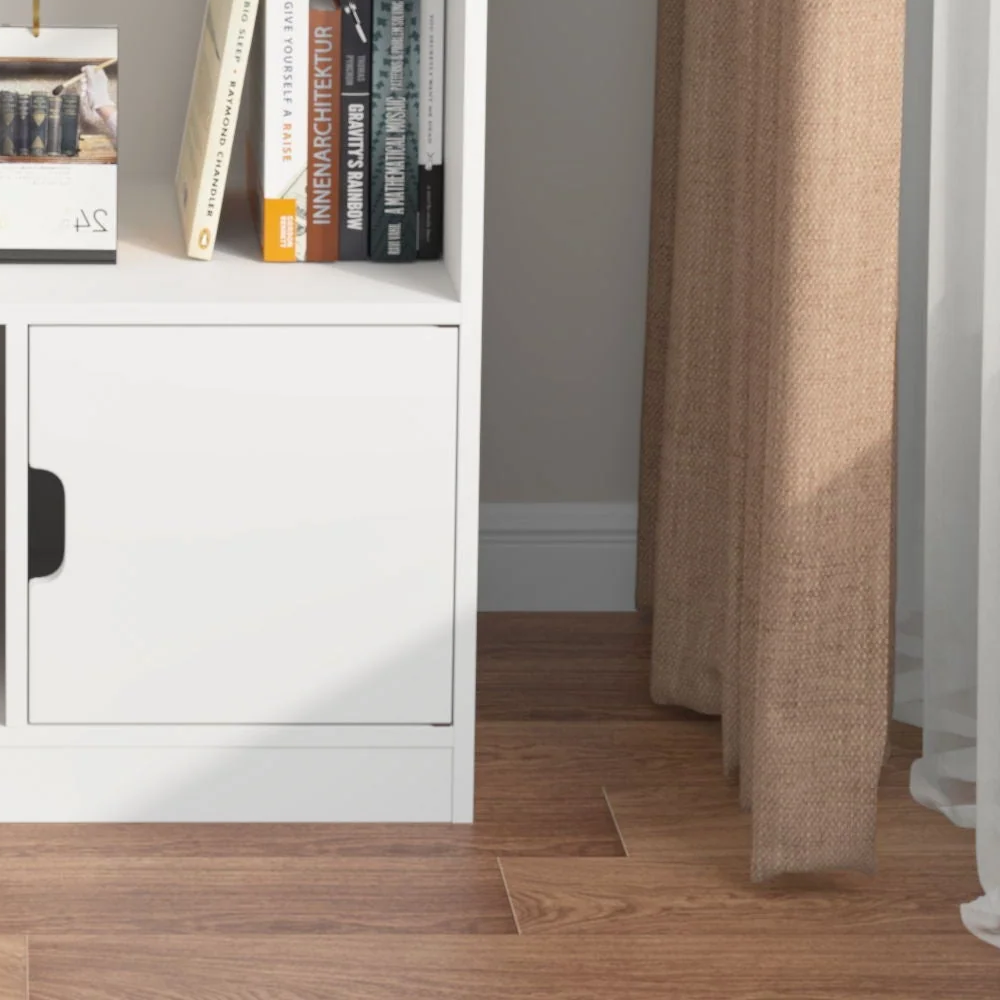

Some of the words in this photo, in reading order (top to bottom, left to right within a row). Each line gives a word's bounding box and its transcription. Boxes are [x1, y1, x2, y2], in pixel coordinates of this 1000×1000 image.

[240, 1, 251, 23] BIG
[284, 1, 293, 32] GIVE
[233, 28, 246, 64] SLEEP
[283, 36, 293, 103] YOURSELF
[218, 80, 237, 146] RAYMOND
[283, 109, 293, 117] A
[283, 123, 293, 162] RAISE
[312, 26, 333, 225] INNENARCHITEKTUR
[347, 103, 364, 167] GRAVITY'S
[384, 96, 406, 133] MOSAIC
[206, 151, 224, 218] CHANDLER
[384, 135, 405, 206] MATHEMATICAL
[347, 171, 364, 230] RAINBOW
